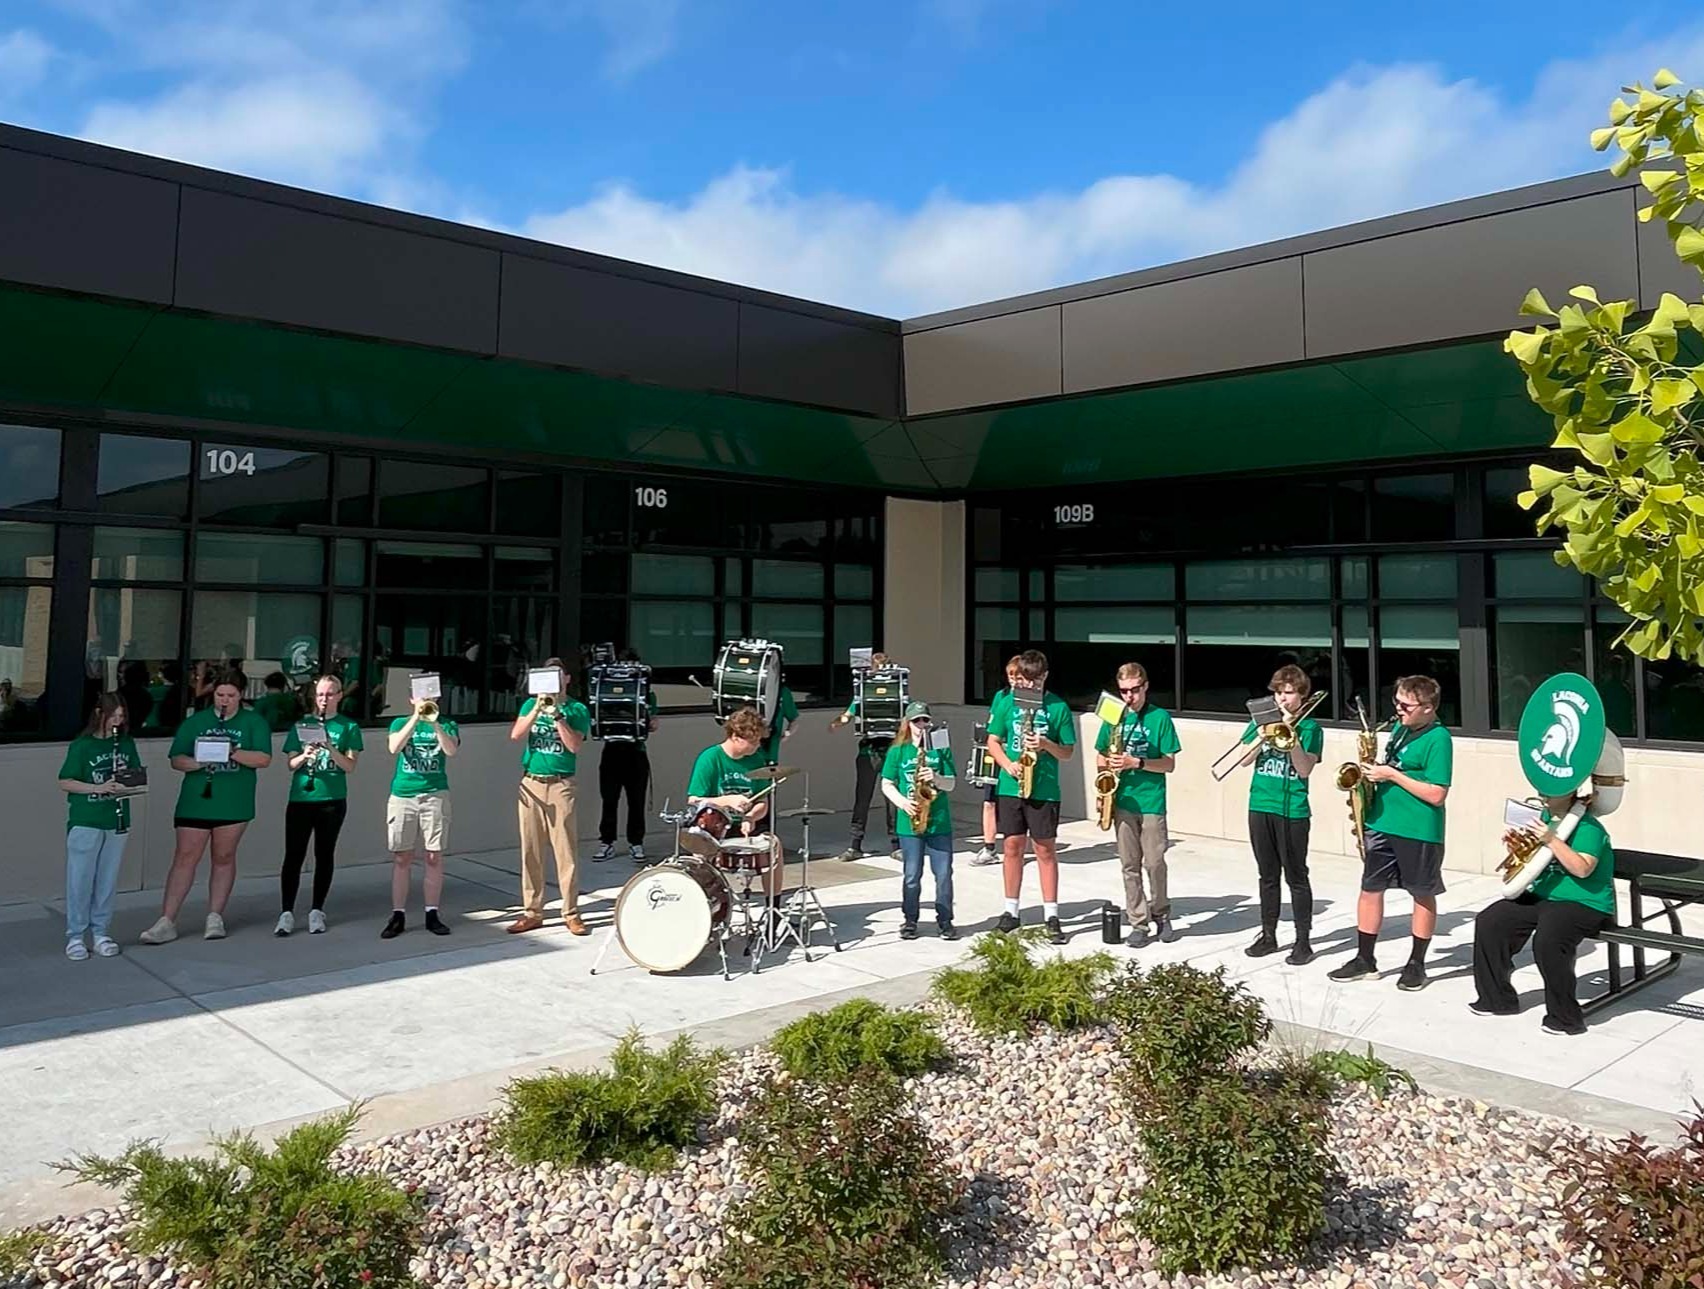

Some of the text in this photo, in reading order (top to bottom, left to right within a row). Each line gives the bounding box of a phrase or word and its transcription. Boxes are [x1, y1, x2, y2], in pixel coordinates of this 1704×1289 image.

[206, 449, 256, 476] 104
[635, 487, 668, 508] 106
[1054, 504, 1094, 523] 109B
